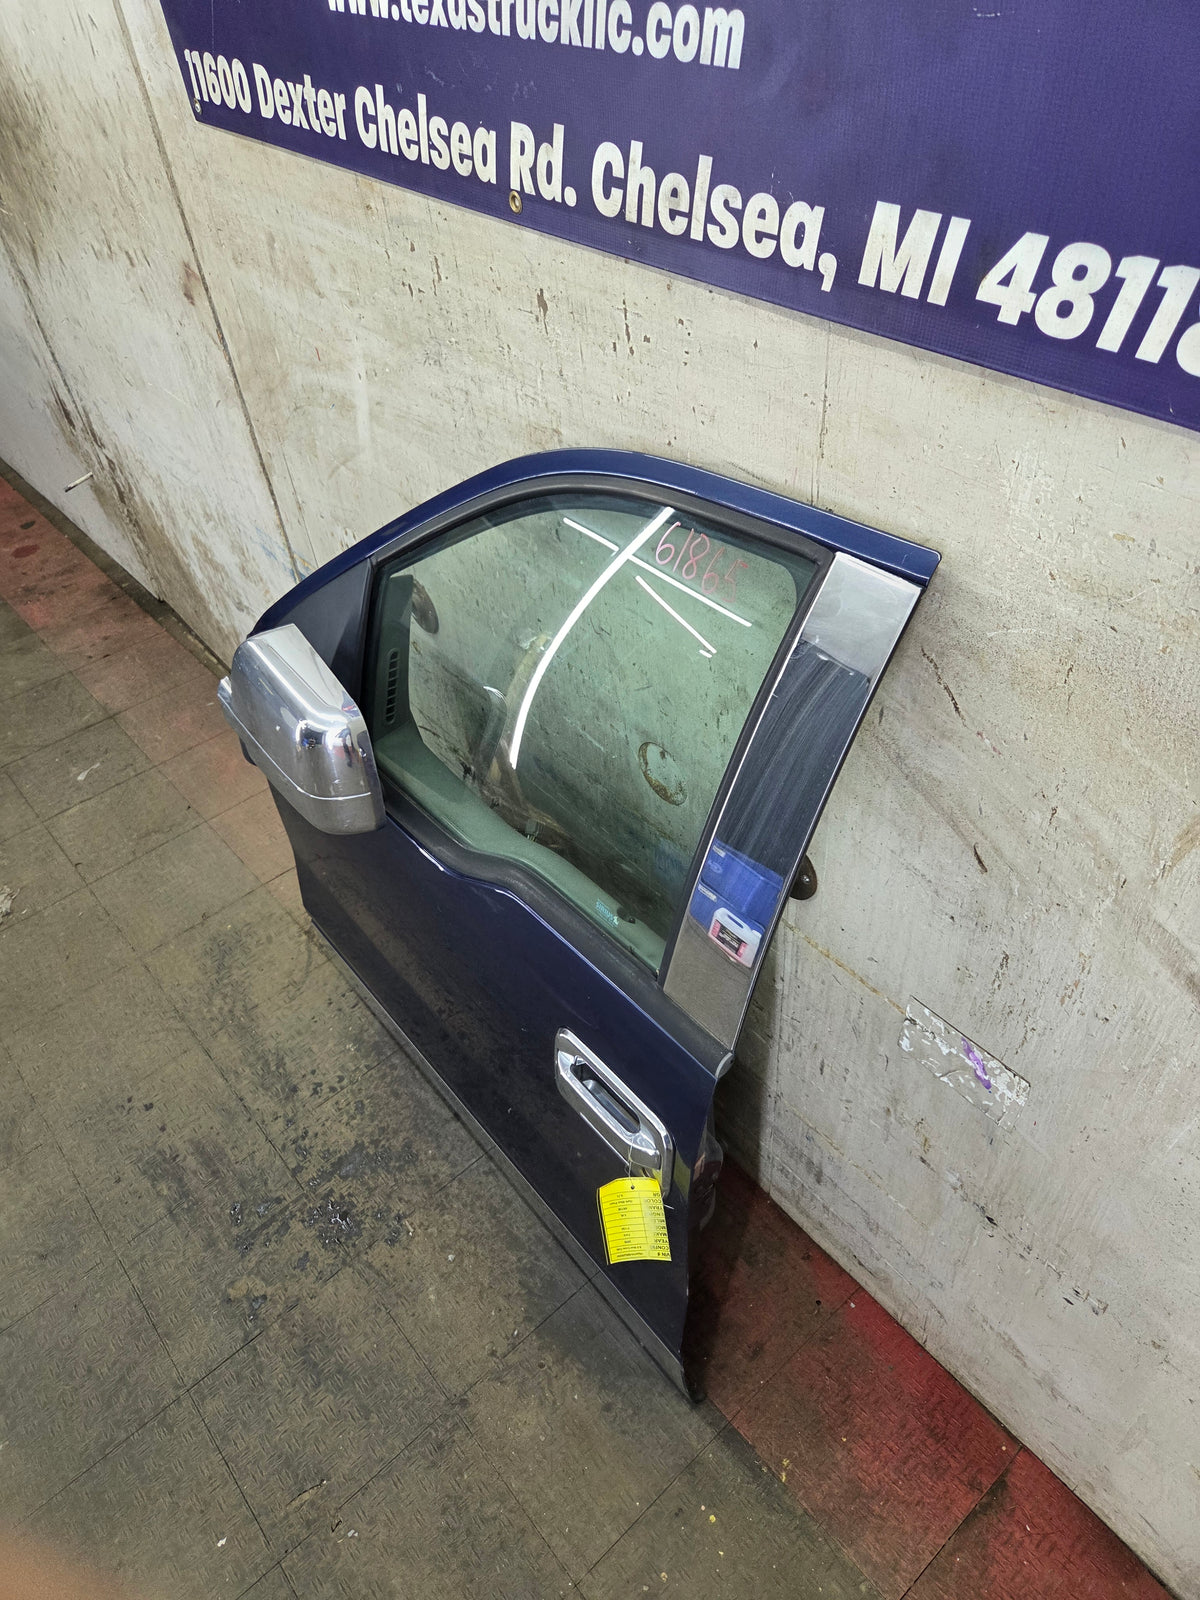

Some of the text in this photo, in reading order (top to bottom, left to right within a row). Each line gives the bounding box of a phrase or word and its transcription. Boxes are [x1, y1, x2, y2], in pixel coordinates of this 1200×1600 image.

[327, 0, 746, 70] .exastruckllc.com
[184, 48, 1200, 378] 11600 Dexter Chelsea Rd. Chelsea, MI 4811
[655, 521, 749, 603] 61865
